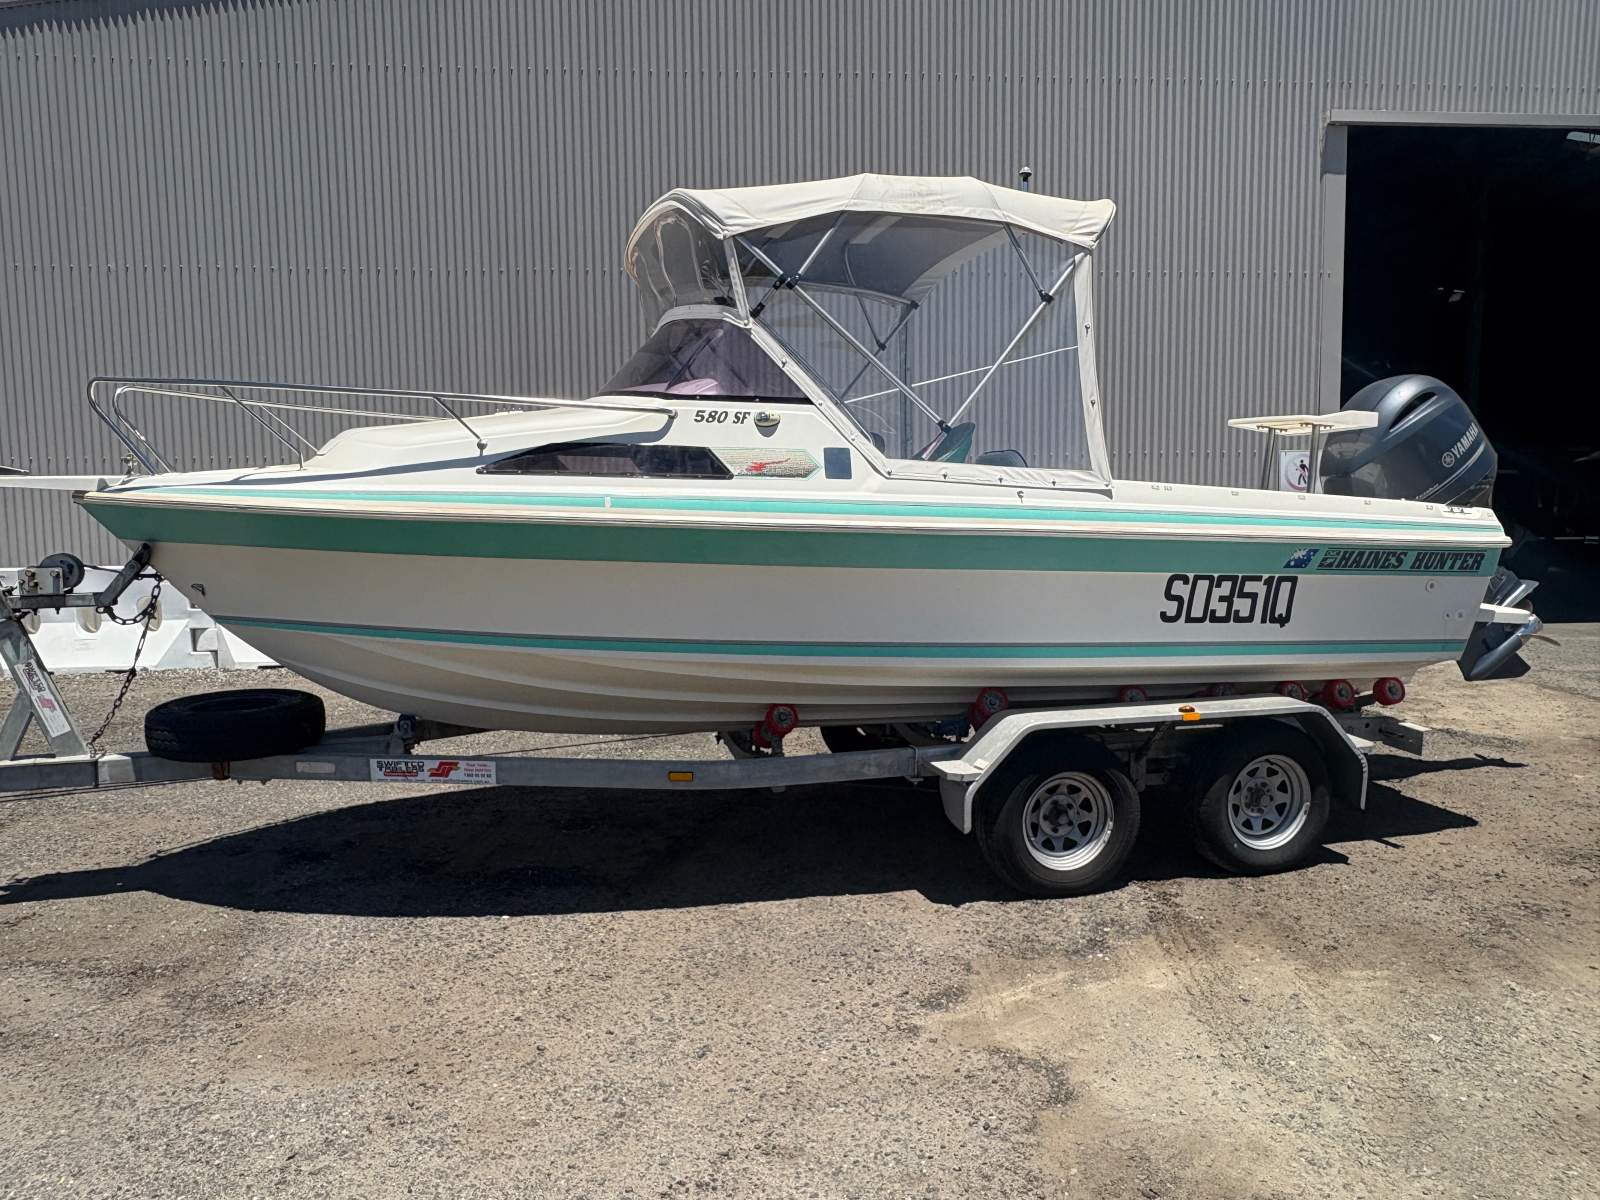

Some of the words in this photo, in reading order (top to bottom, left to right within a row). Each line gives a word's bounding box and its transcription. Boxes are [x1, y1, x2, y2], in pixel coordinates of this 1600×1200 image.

[693, 409, 729, 424] 580
[732, 410, 751, 425] SF
[1450, 422, 1479, 459] YAMAHA
[1334, 550, 1409, 569] HAINES
[1409, 552, 1486, 571] HUNTER
